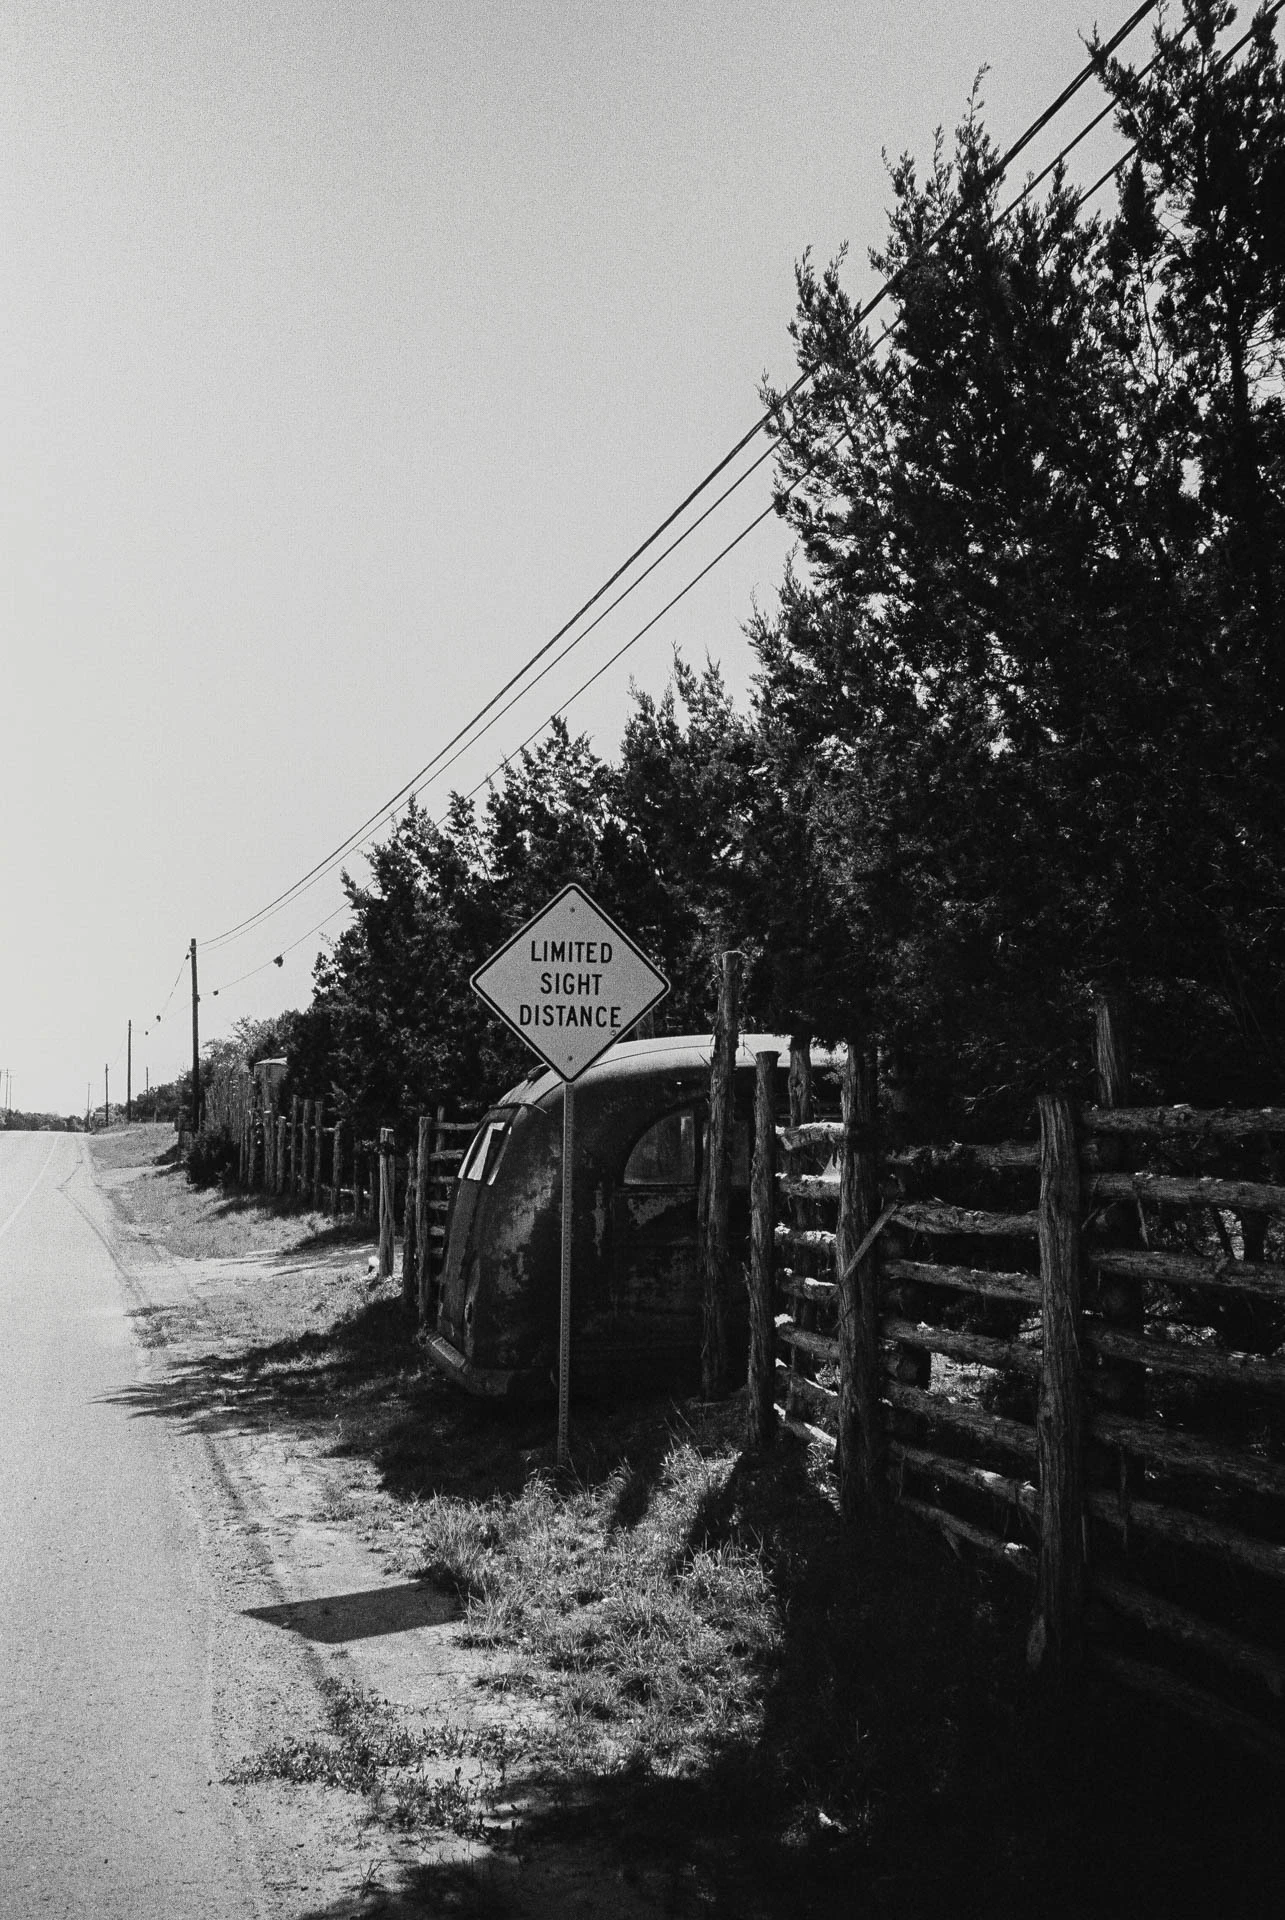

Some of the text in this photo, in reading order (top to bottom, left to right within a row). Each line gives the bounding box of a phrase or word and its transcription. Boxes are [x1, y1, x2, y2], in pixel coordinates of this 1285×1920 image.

[531, 940, 613, 963] LIMITED
[540, 972, 602, 995] SIGHT
[519, 1004, 621, 1028] DISTANCE
